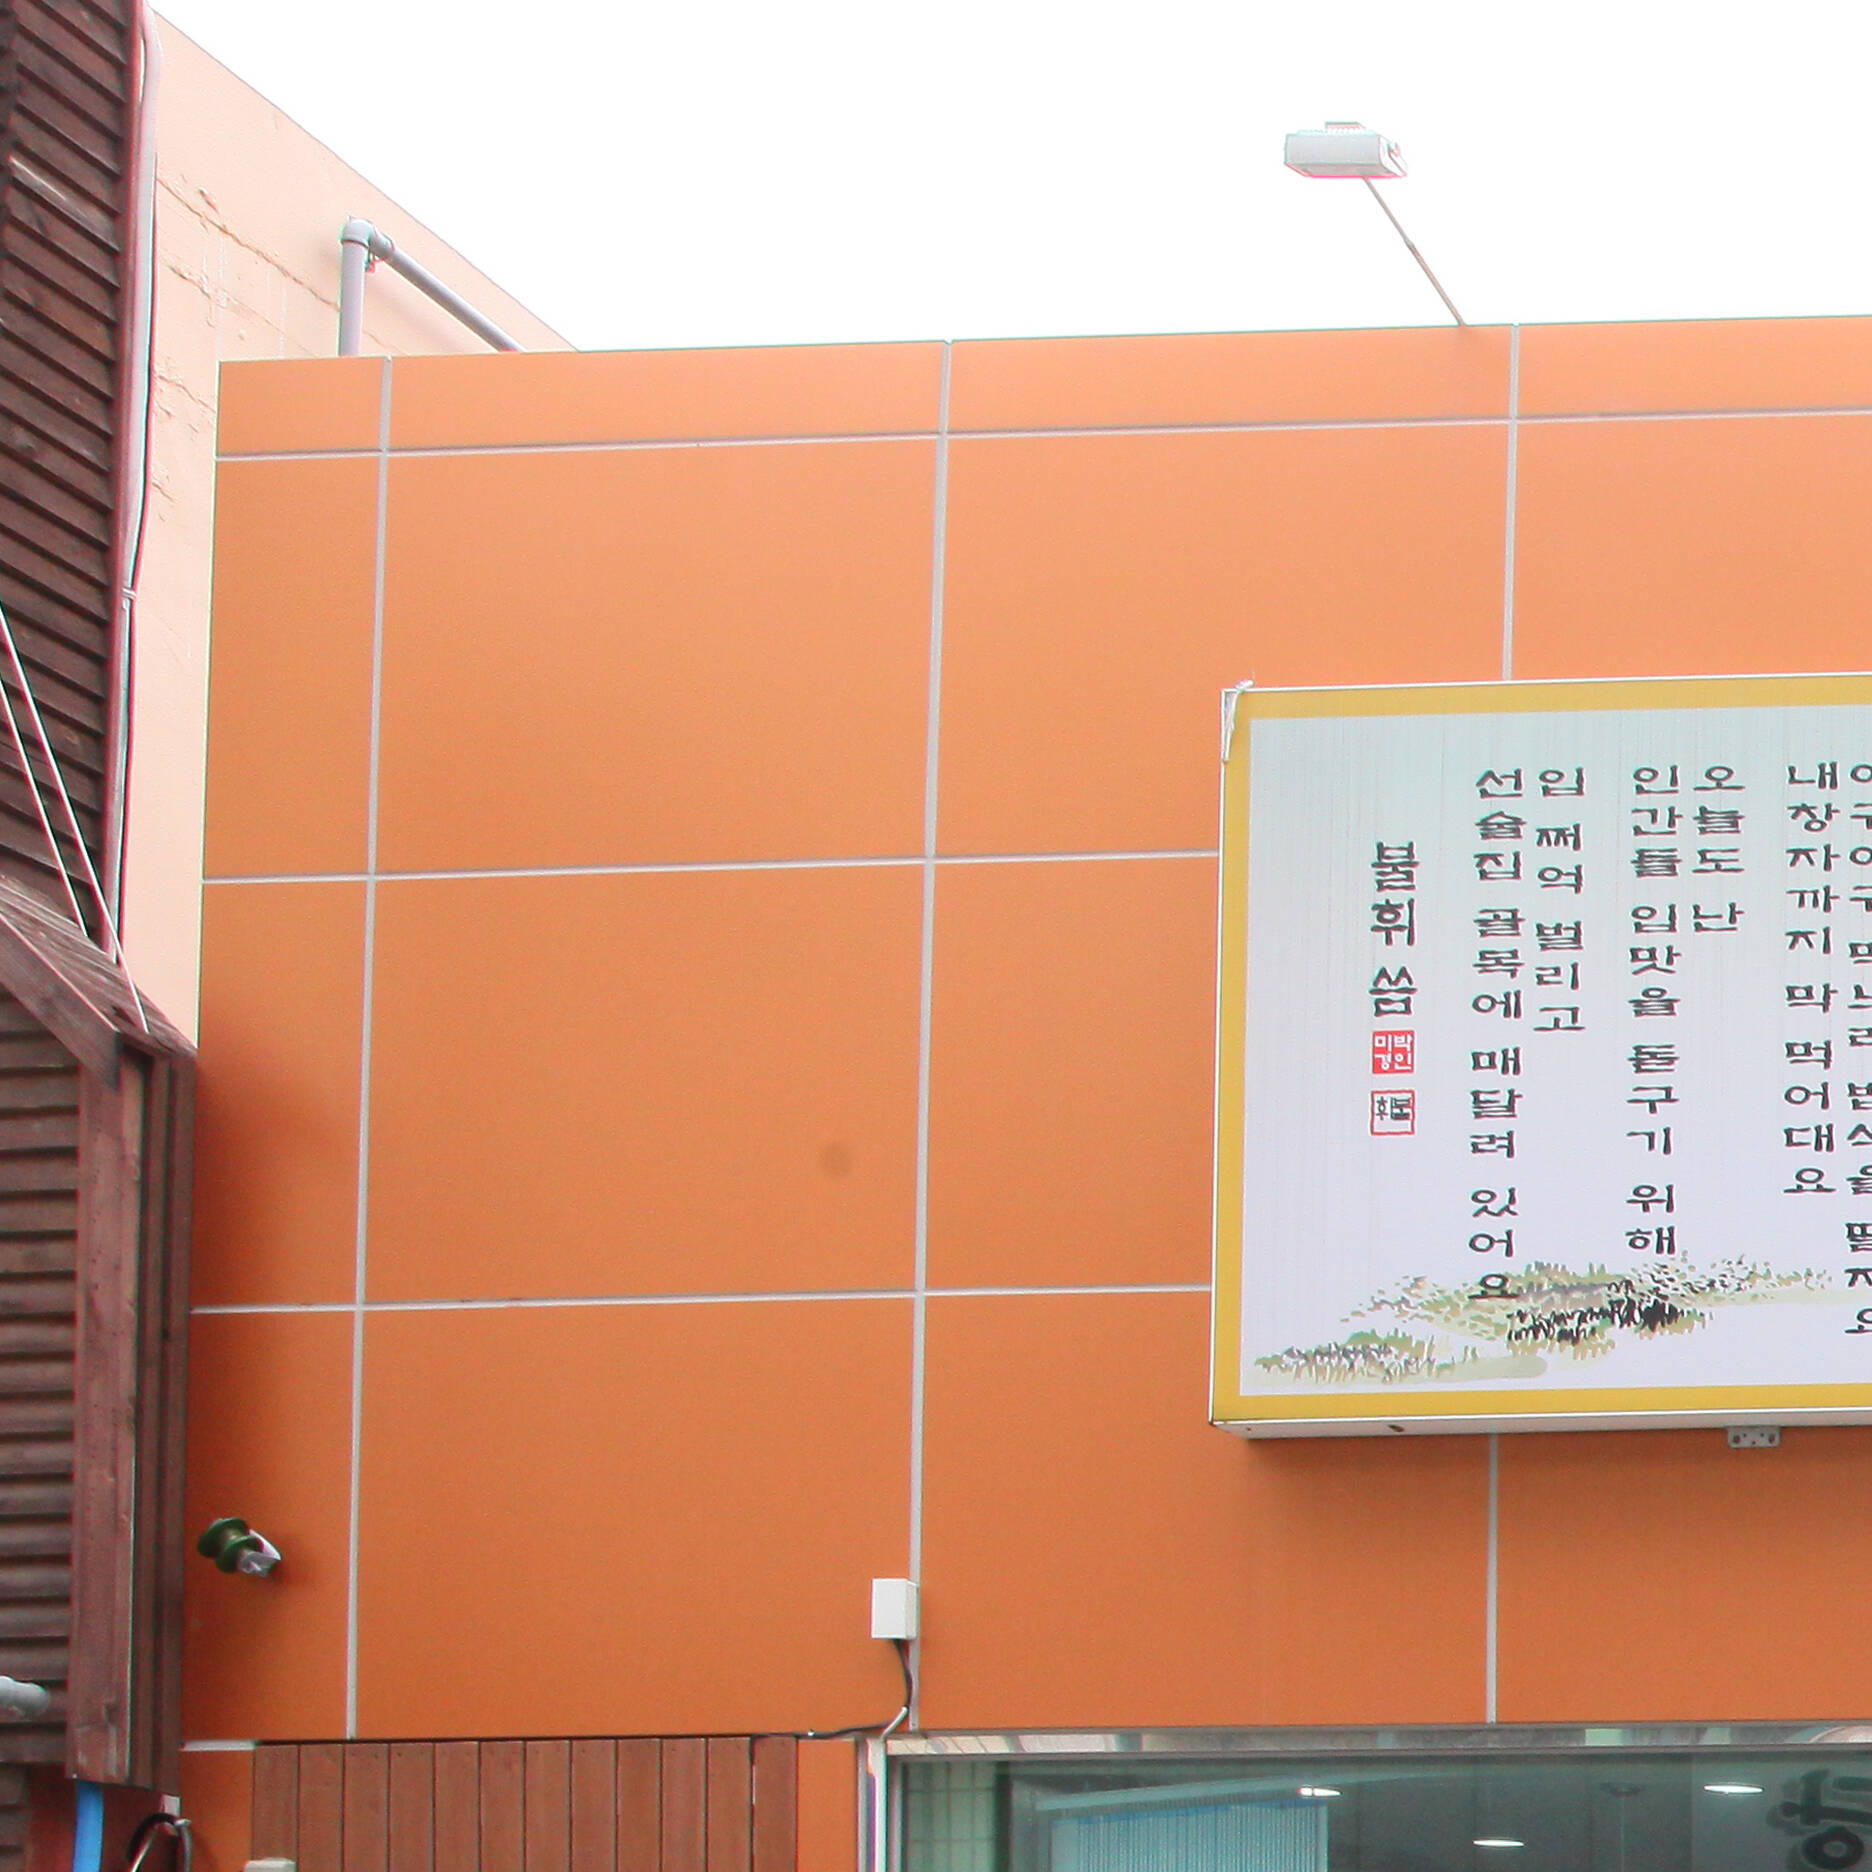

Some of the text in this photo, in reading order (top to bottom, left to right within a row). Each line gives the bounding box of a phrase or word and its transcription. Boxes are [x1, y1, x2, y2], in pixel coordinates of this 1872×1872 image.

[1631, 765, 1682, 877] 인간들
[1692, 766, 1743, 932] 오늘도 난
[1534, 768, 1584, 1031] 입 쩌억 벌리고
[1369, 966, 1416, 1017] 씀
[1629, 904, 1680, 1017] 입맛을
[1786, 983, 1838, 1013] 막
[1468, 769, 1522, 1301] 선술집 골목에 매달려 있어요
[1784, 1040, 1834, 1193] 먹어대요
[1625, 1184, 1675, 1255] 위해
